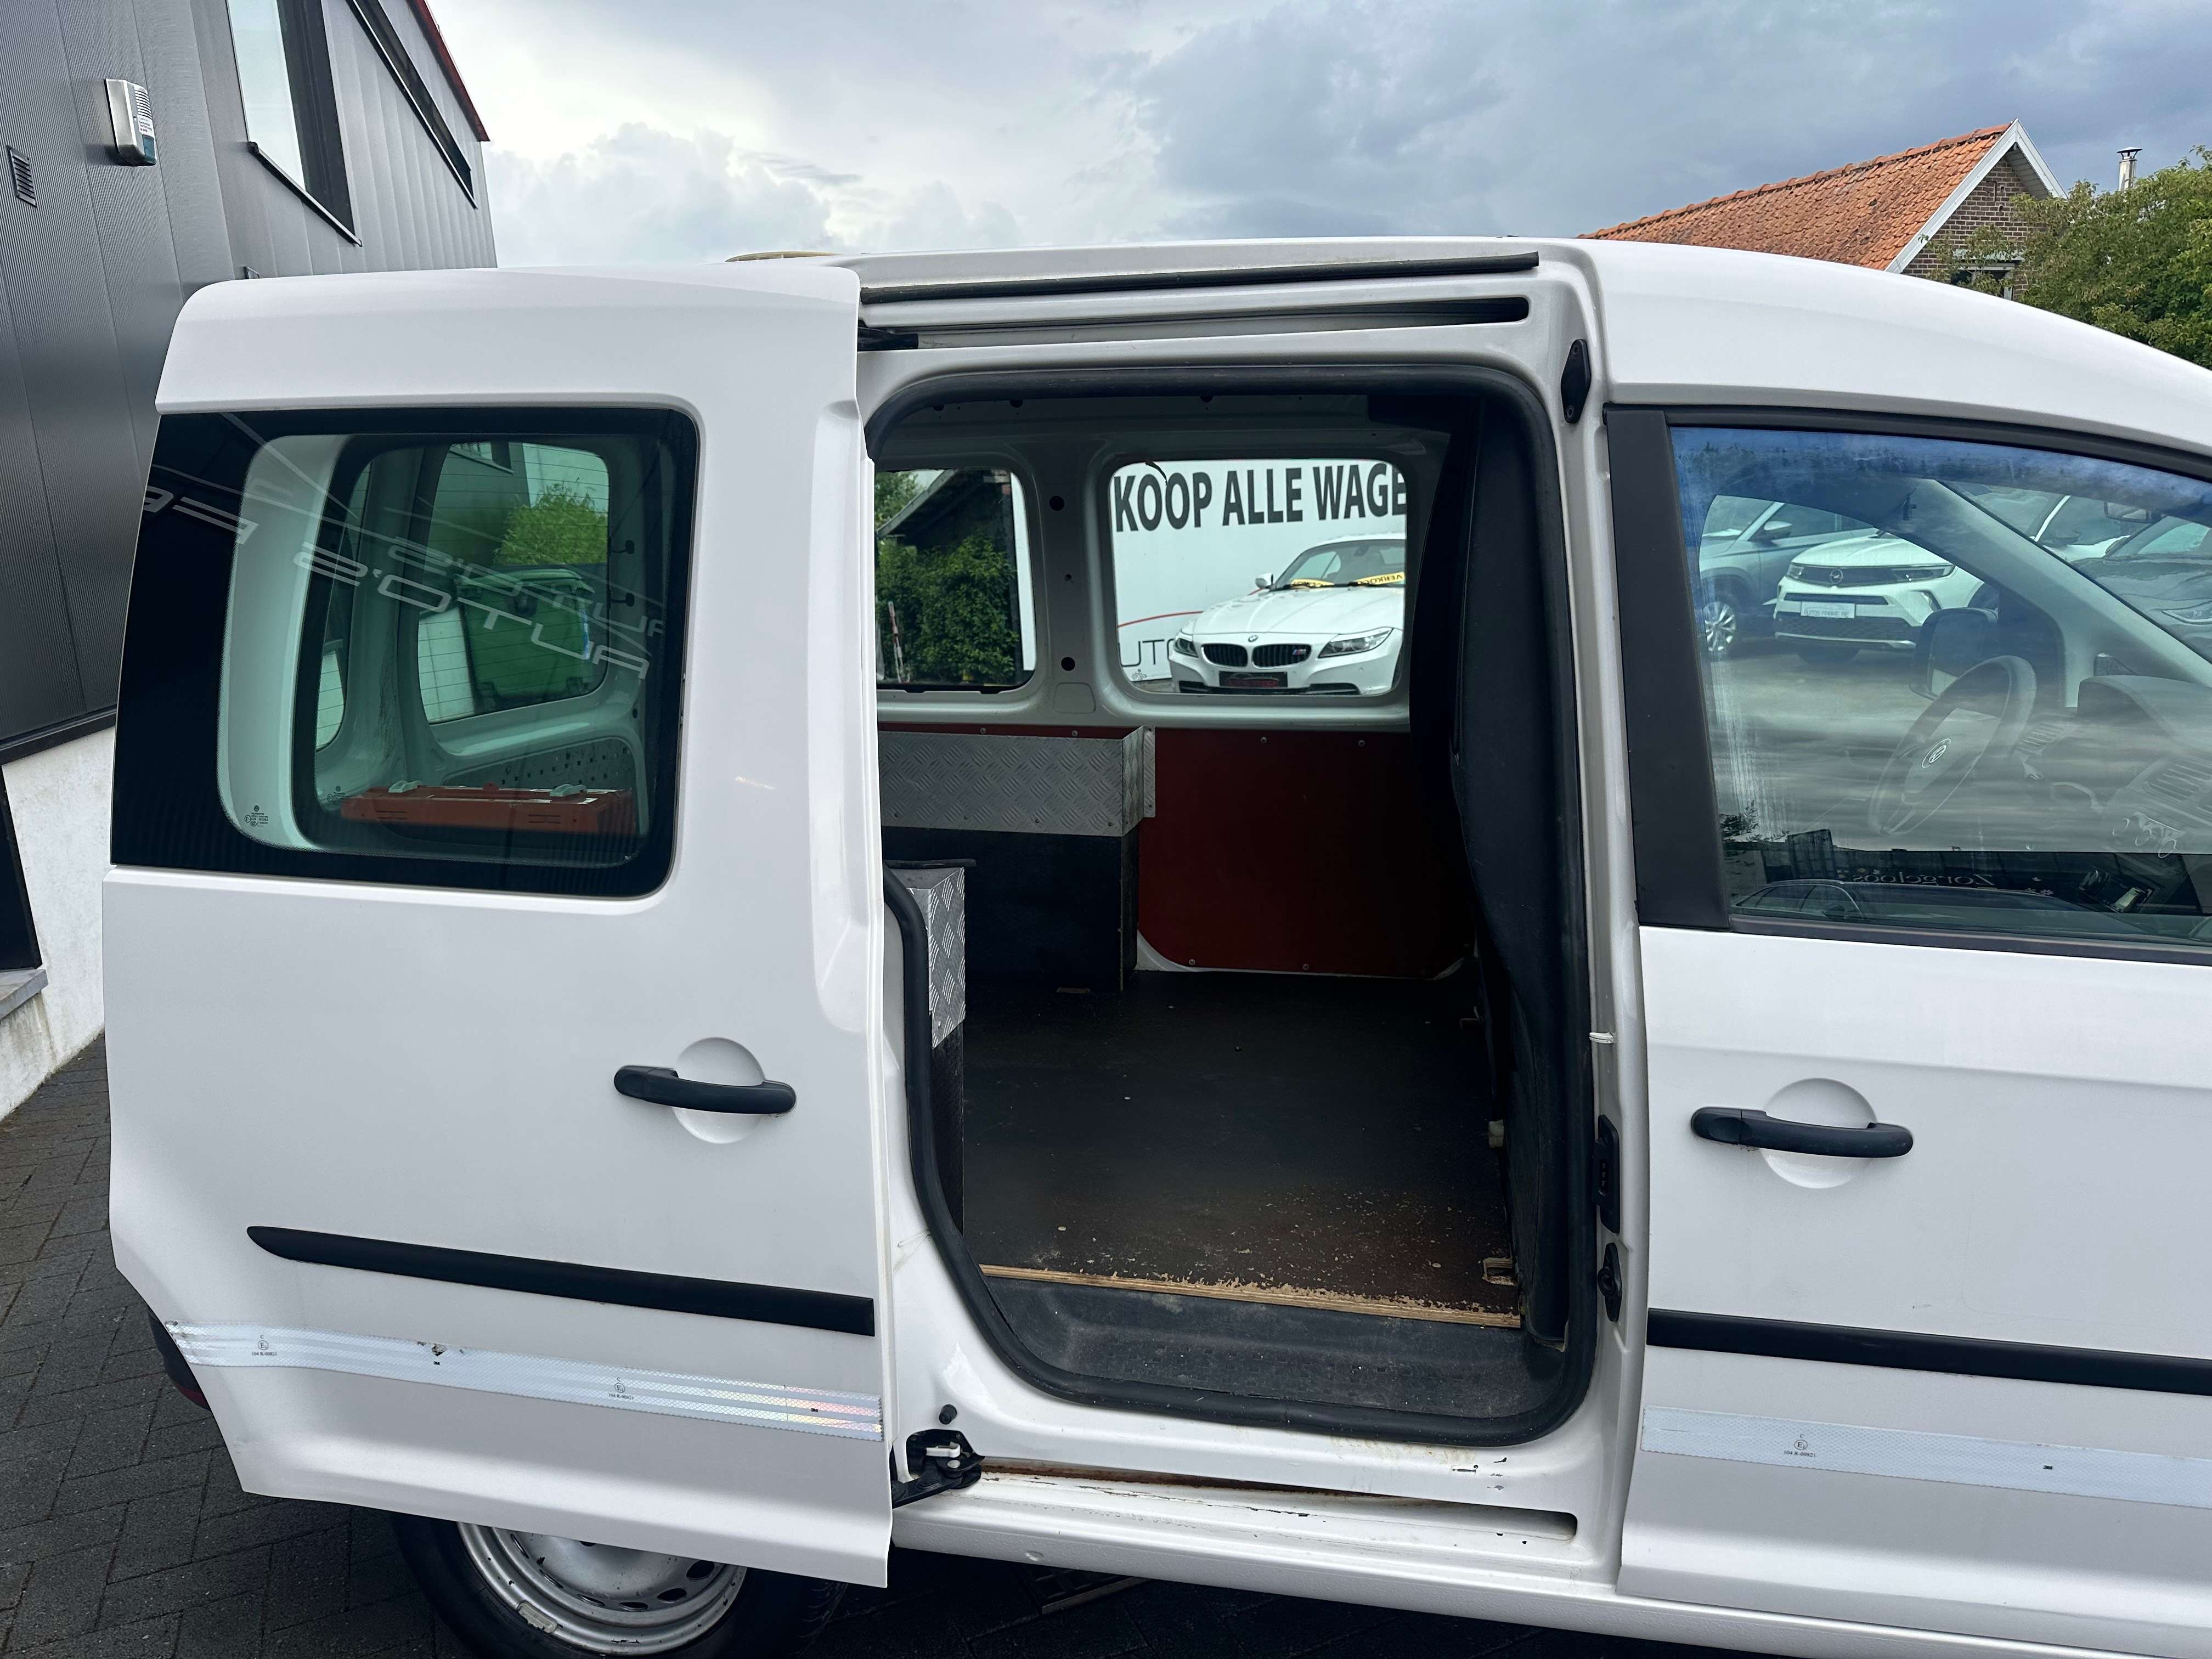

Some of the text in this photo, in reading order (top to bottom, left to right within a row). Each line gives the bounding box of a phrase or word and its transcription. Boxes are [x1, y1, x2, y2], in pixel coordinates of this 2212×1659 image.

[1114, 463, 1407, 532] KOOP ALLE WAGE
